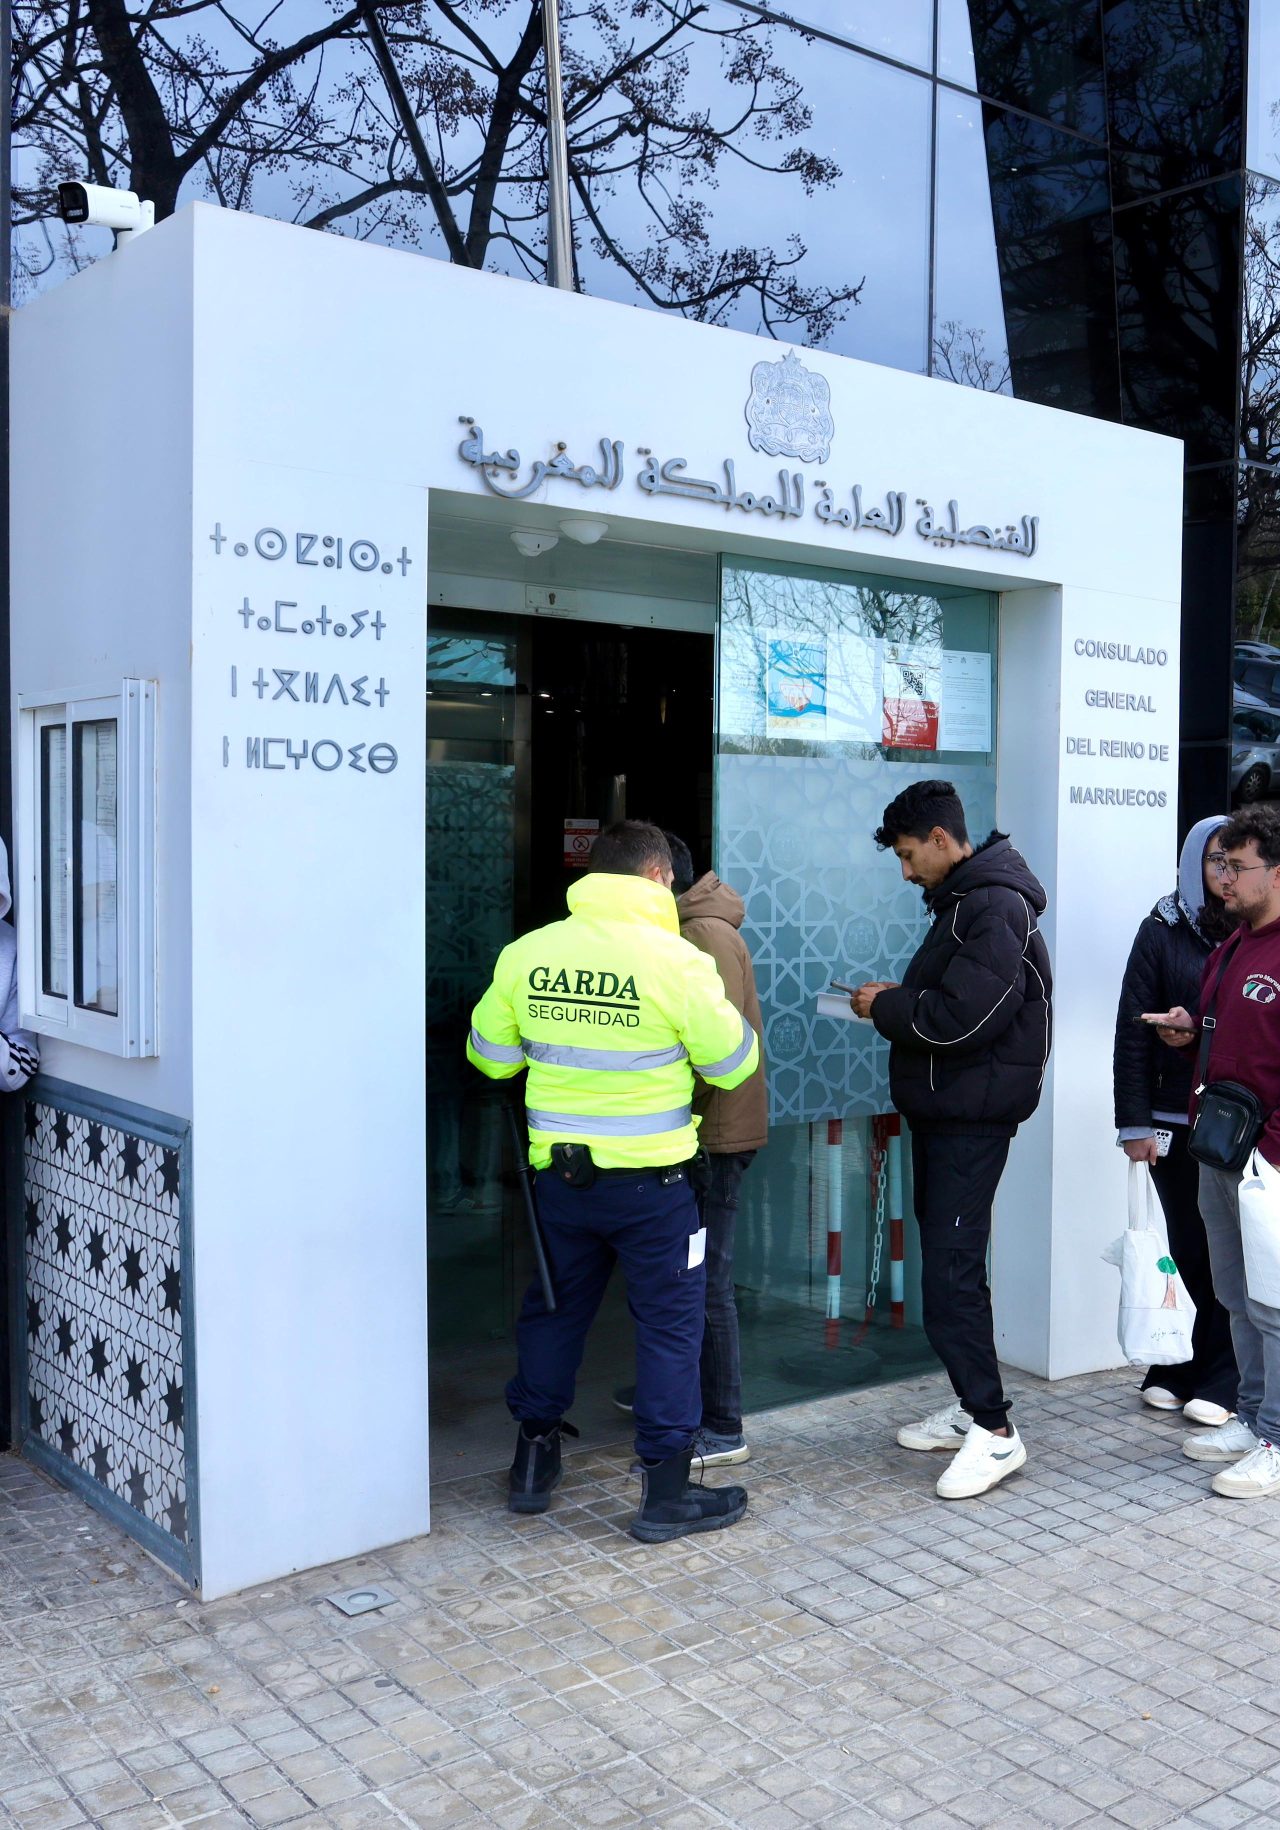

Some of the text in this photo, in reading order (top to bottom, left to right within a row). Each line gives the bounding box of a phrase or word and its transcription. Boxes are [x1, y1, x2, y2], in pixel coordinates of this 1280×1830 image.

[458, 415, 1040, 557] القنصلية العامة للمملكة المغربية
[1074, 638, 1168, 666] CONSULADO
[1085, 689, 1157, 713] GENERAL
[1066, 736, 1169, 762] DEL REINO DE
[1069, 786, 1168, 807] MARRUECOS
[528, 966, 640, 1001] GARDA
[528, 1003, 640, 1028] SEGURIDAD
